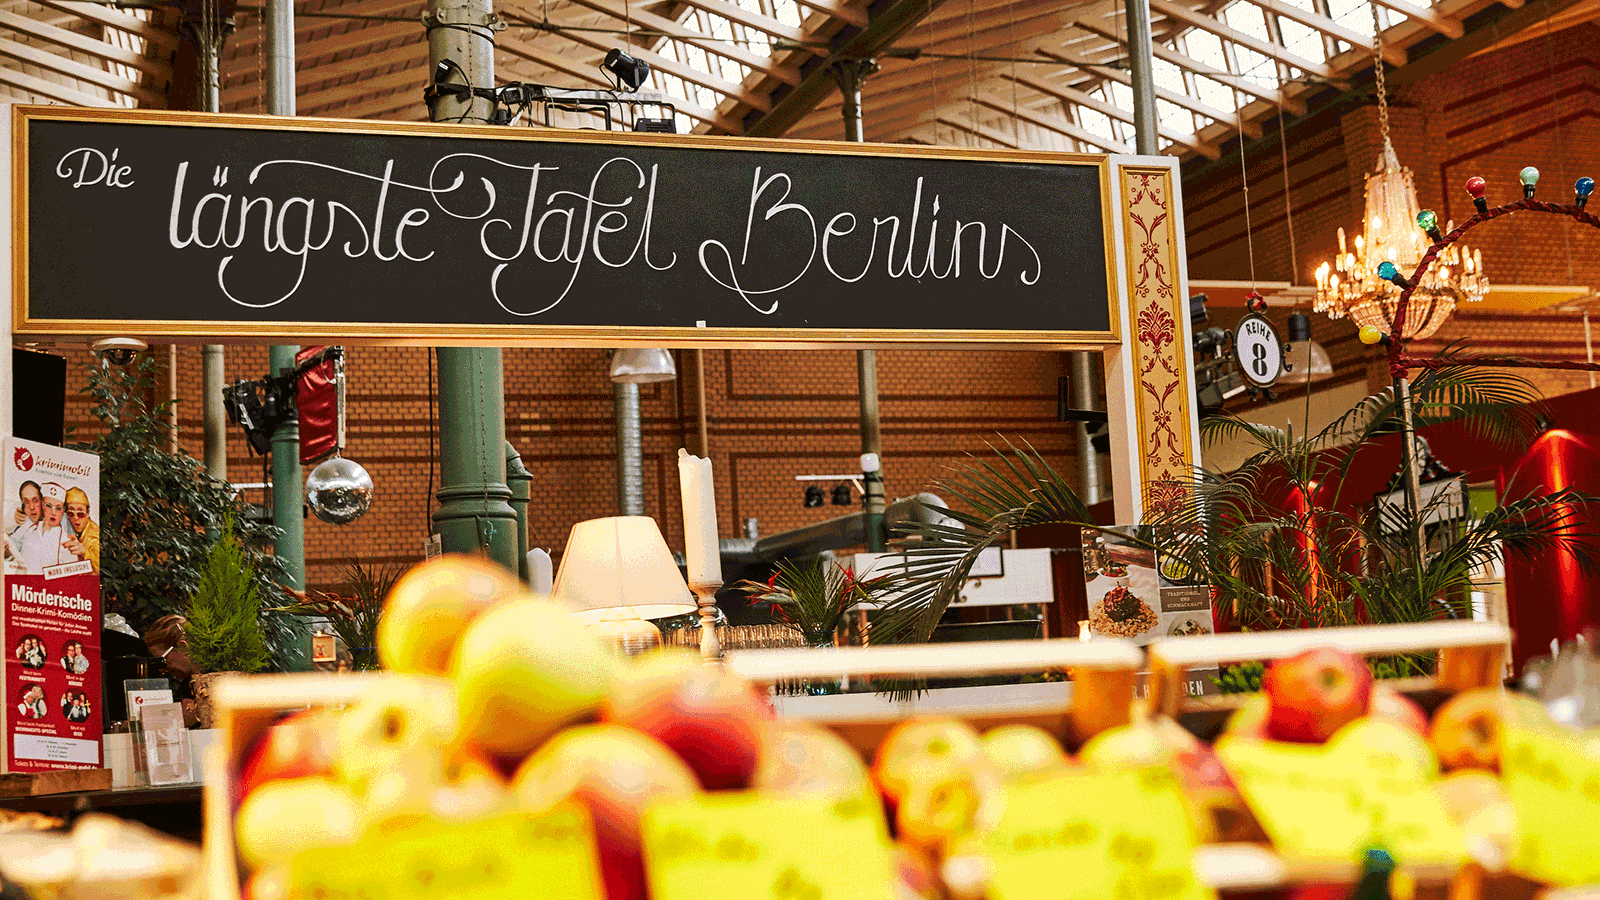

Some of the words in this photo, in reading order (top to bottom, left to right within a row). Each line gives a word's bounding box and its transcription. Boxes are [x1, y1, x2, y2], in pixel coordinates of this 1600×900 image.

[56, 147, 135, 189] Die
[169, 159, 464, 308] längste
[430, 152, 678, 316] Tafel
[698, 165, 1043, 315] Berlins
[1246, 322, 1271, 341] REIHE
[1252, 343, 1267, 376] 8
[35, 455, 92, 477] krimimobil
[11, 583, 93, 612] Mörderische
[11, 602, 93, 622] Dinner-Krimi-Komödien
